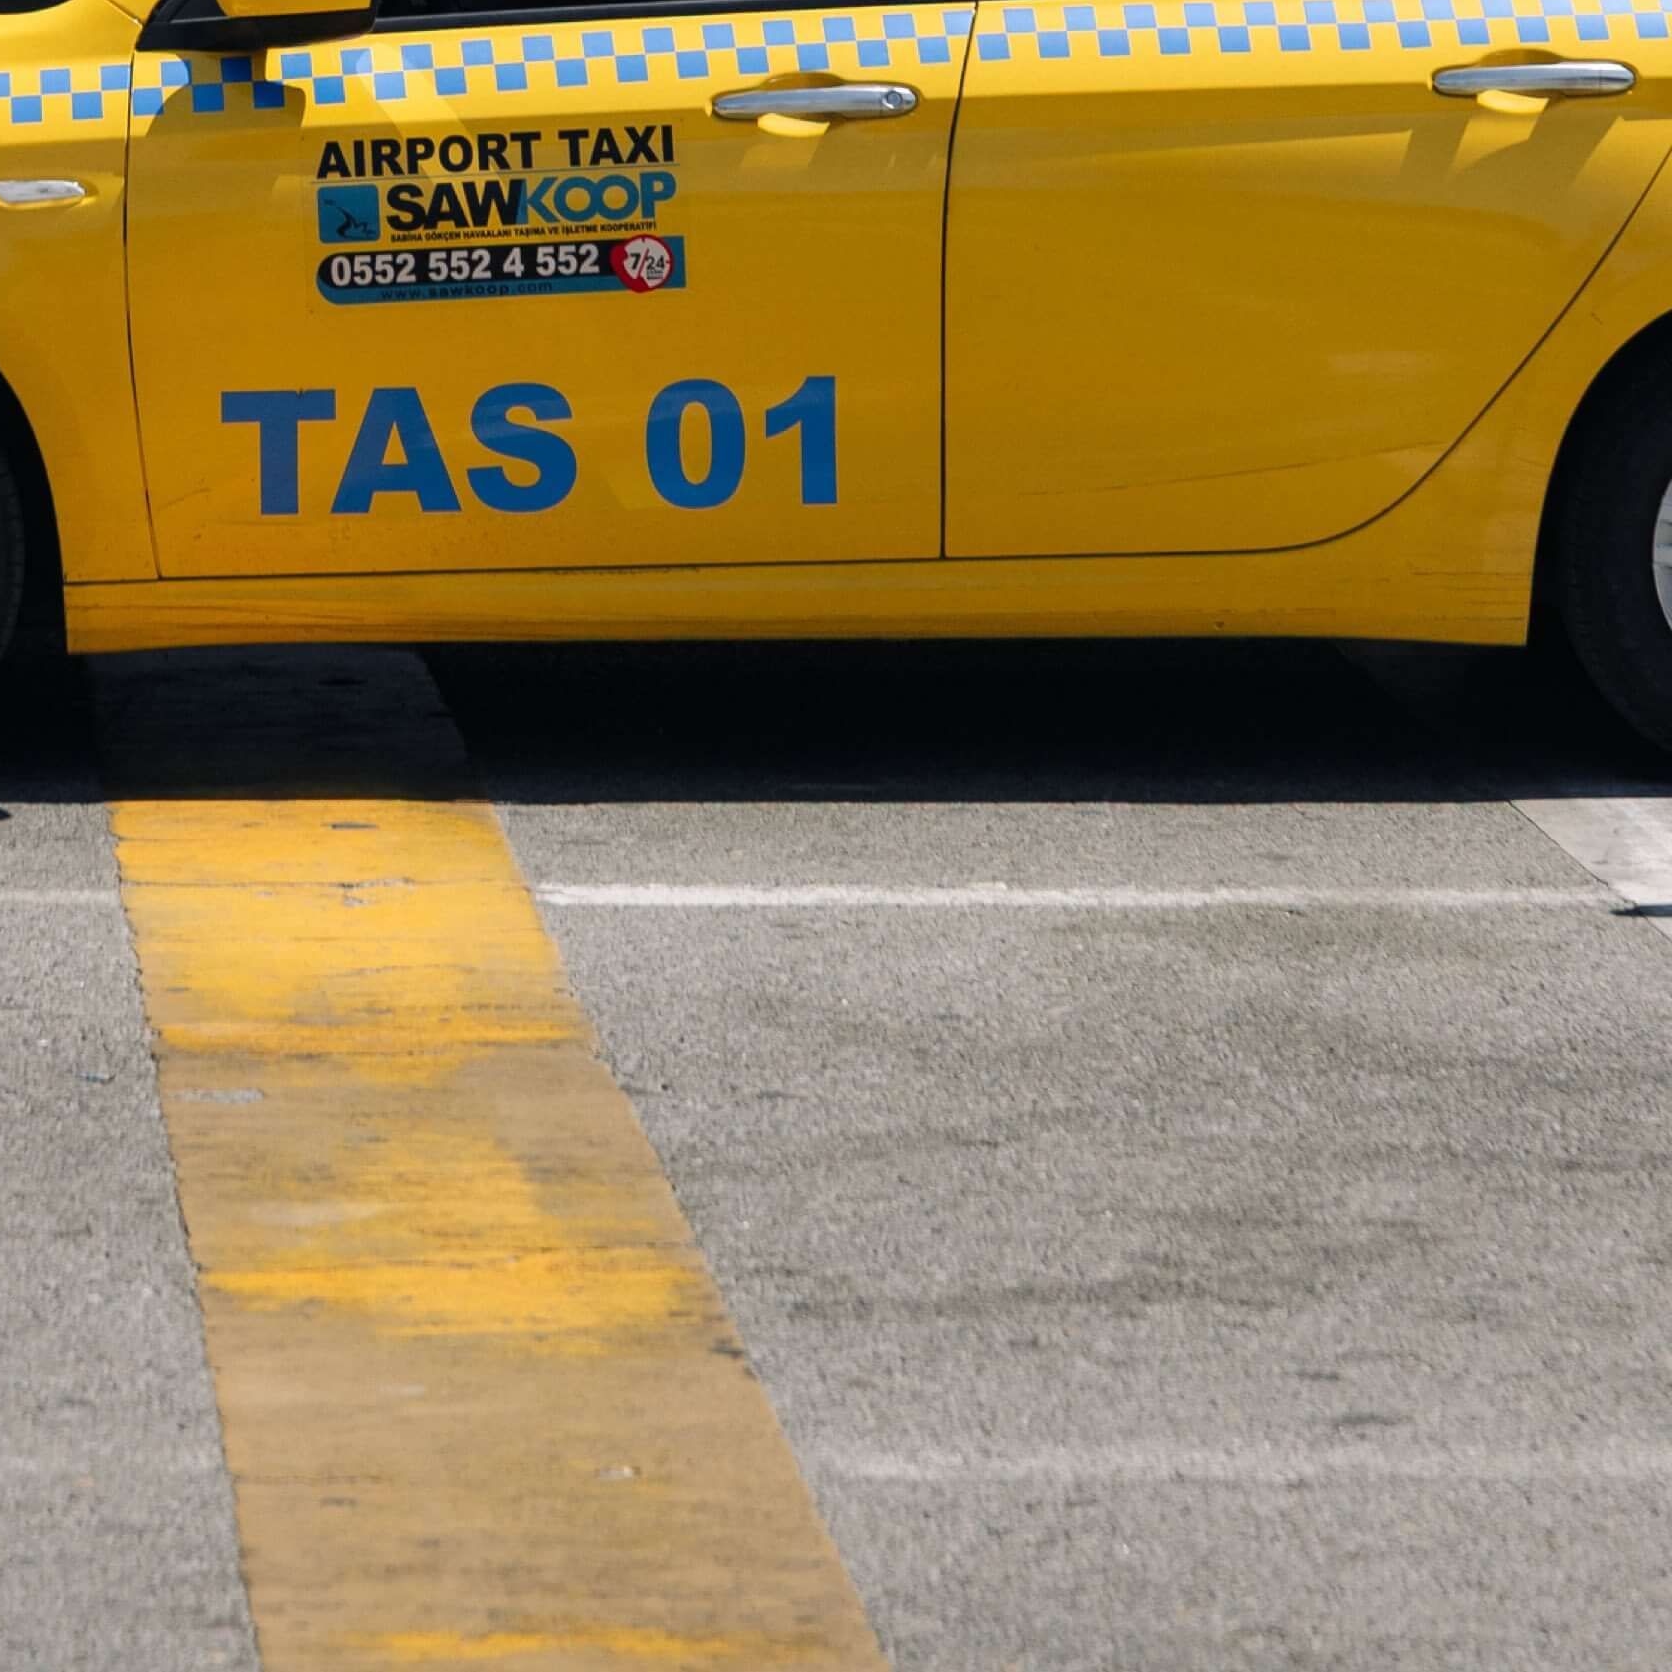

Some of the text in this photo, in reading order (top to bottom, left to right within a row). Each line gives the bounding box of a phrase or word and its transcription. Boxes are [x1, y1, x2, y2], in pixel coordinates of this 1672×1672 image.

[316, 125, 674, 179] AIRPORT TAXI
[386, 171, 676, 231] SAWKOOP
[330, 243, 600, 287] 0552 552 4 552
[221, 376, 838, 515] TAS 01
